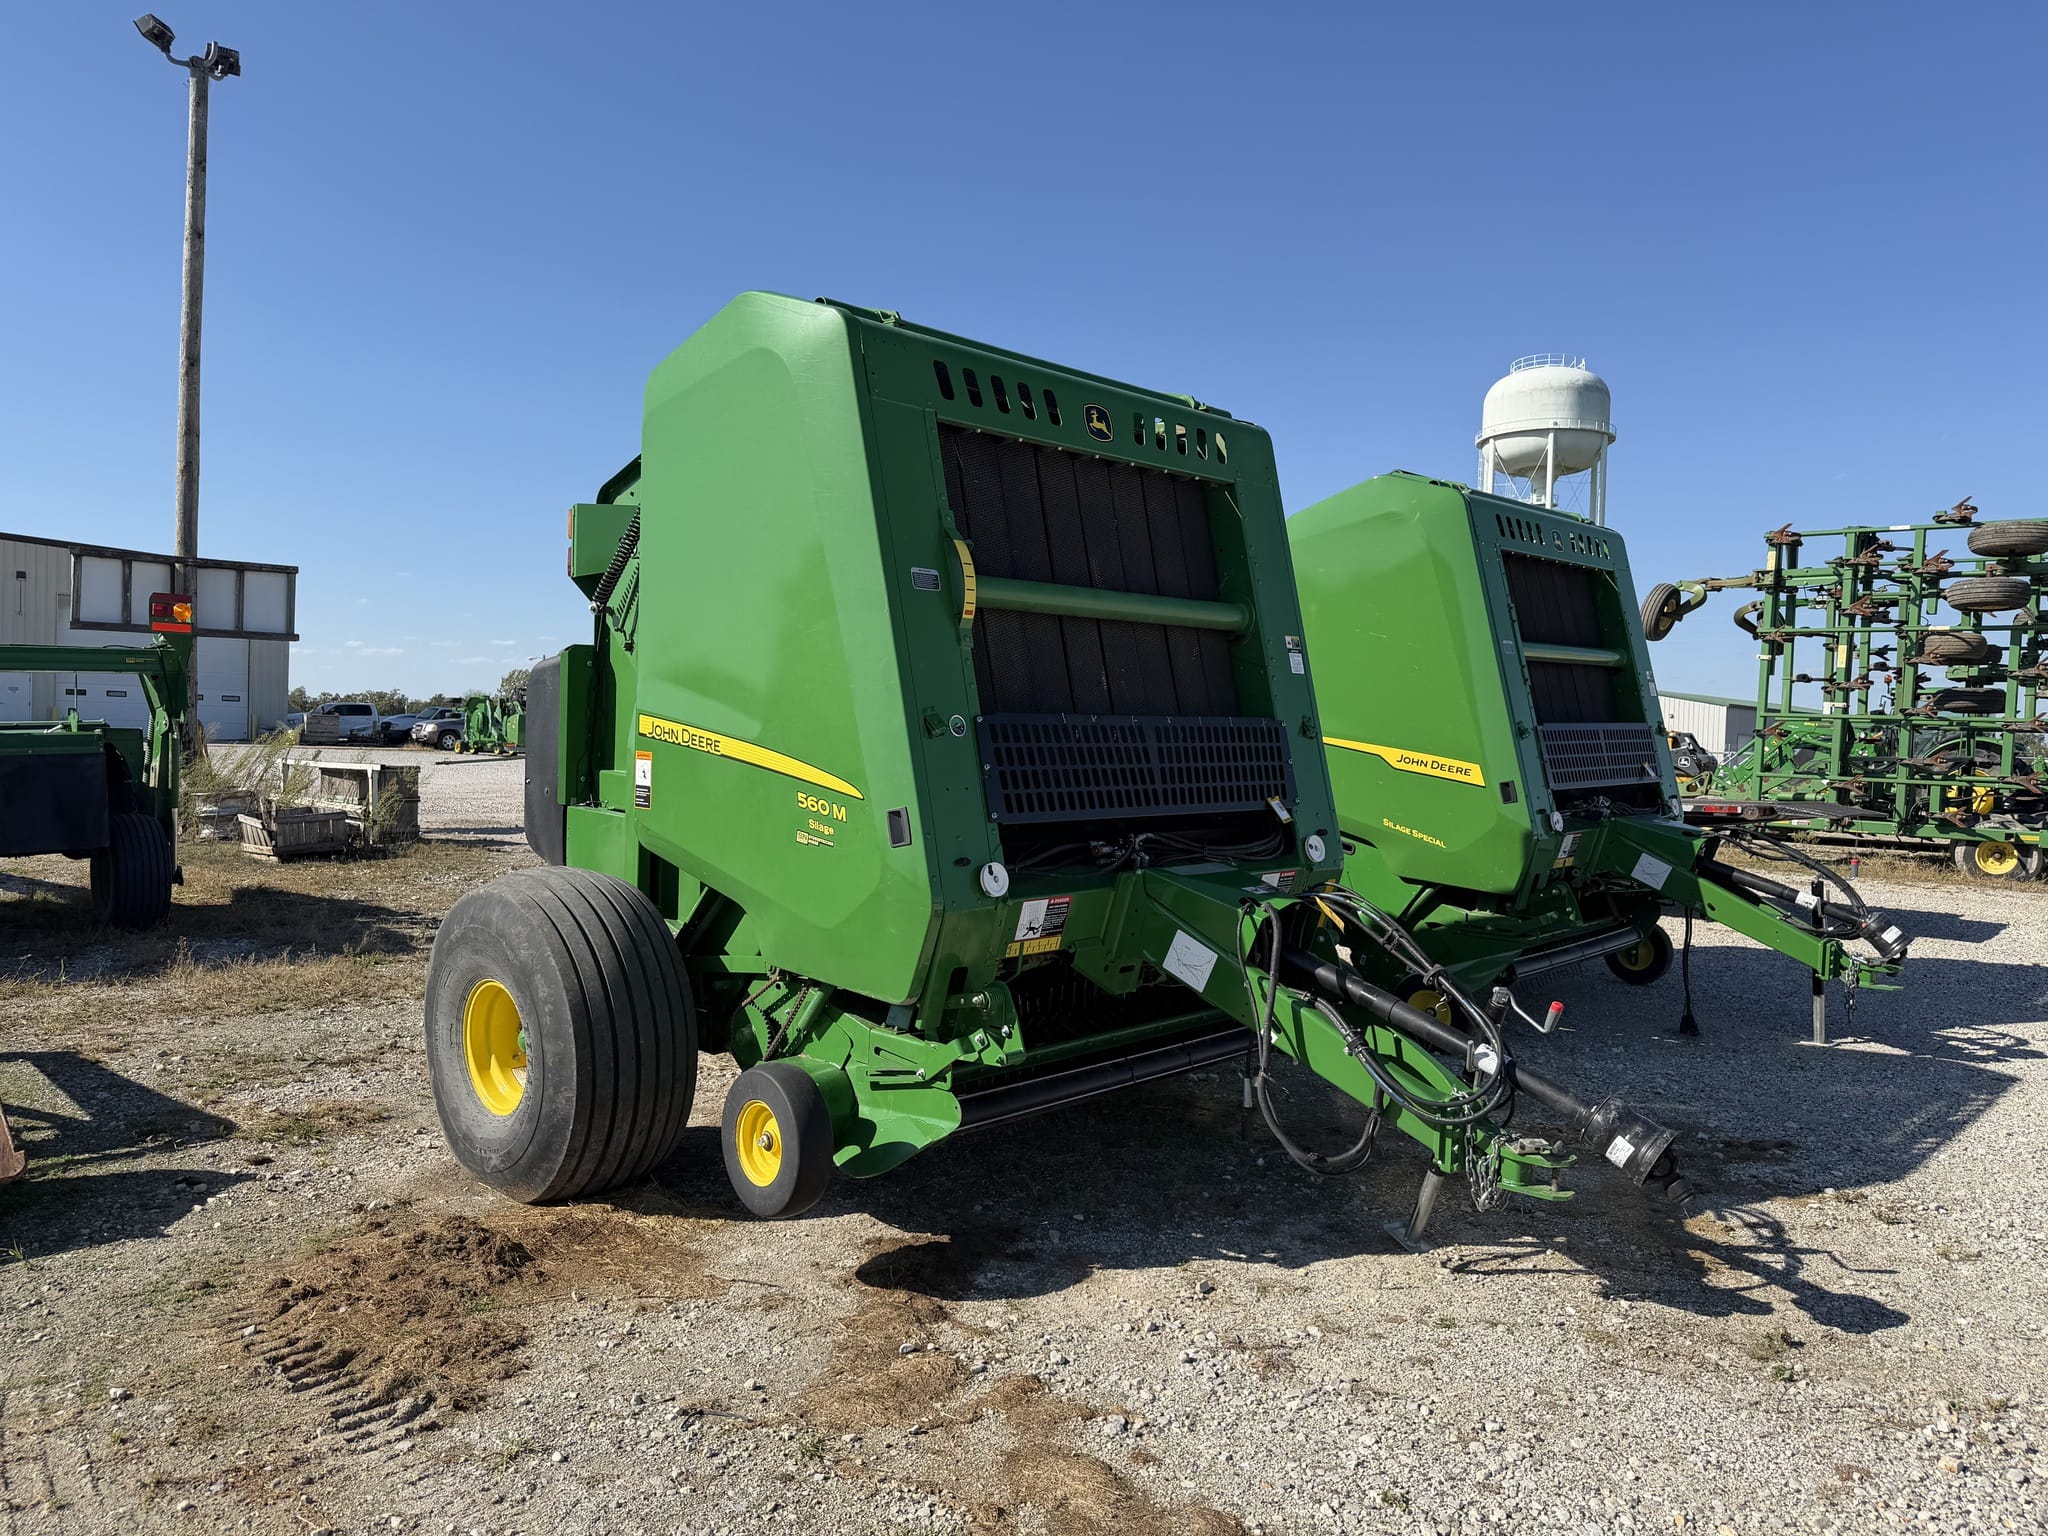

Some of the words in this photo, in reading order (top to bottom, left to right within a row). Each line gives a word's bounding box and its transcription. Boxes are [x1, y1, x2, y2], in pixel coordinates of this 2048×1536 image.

[648, 721, 678, 744] JOHN
[682, 729, 721, 753] DEERE
[1397, 755, 1428, 768] JOHN
[1431, 761, 1472, 777] DEERE
[797, 791, 830, 816] 560
[832, 803, 847, 823] M
[808, 818, 834, 836] Silage
[1383, 818, 1411, 836] SILAGE
[1412, 829, 1446, 849] SPECIAL
